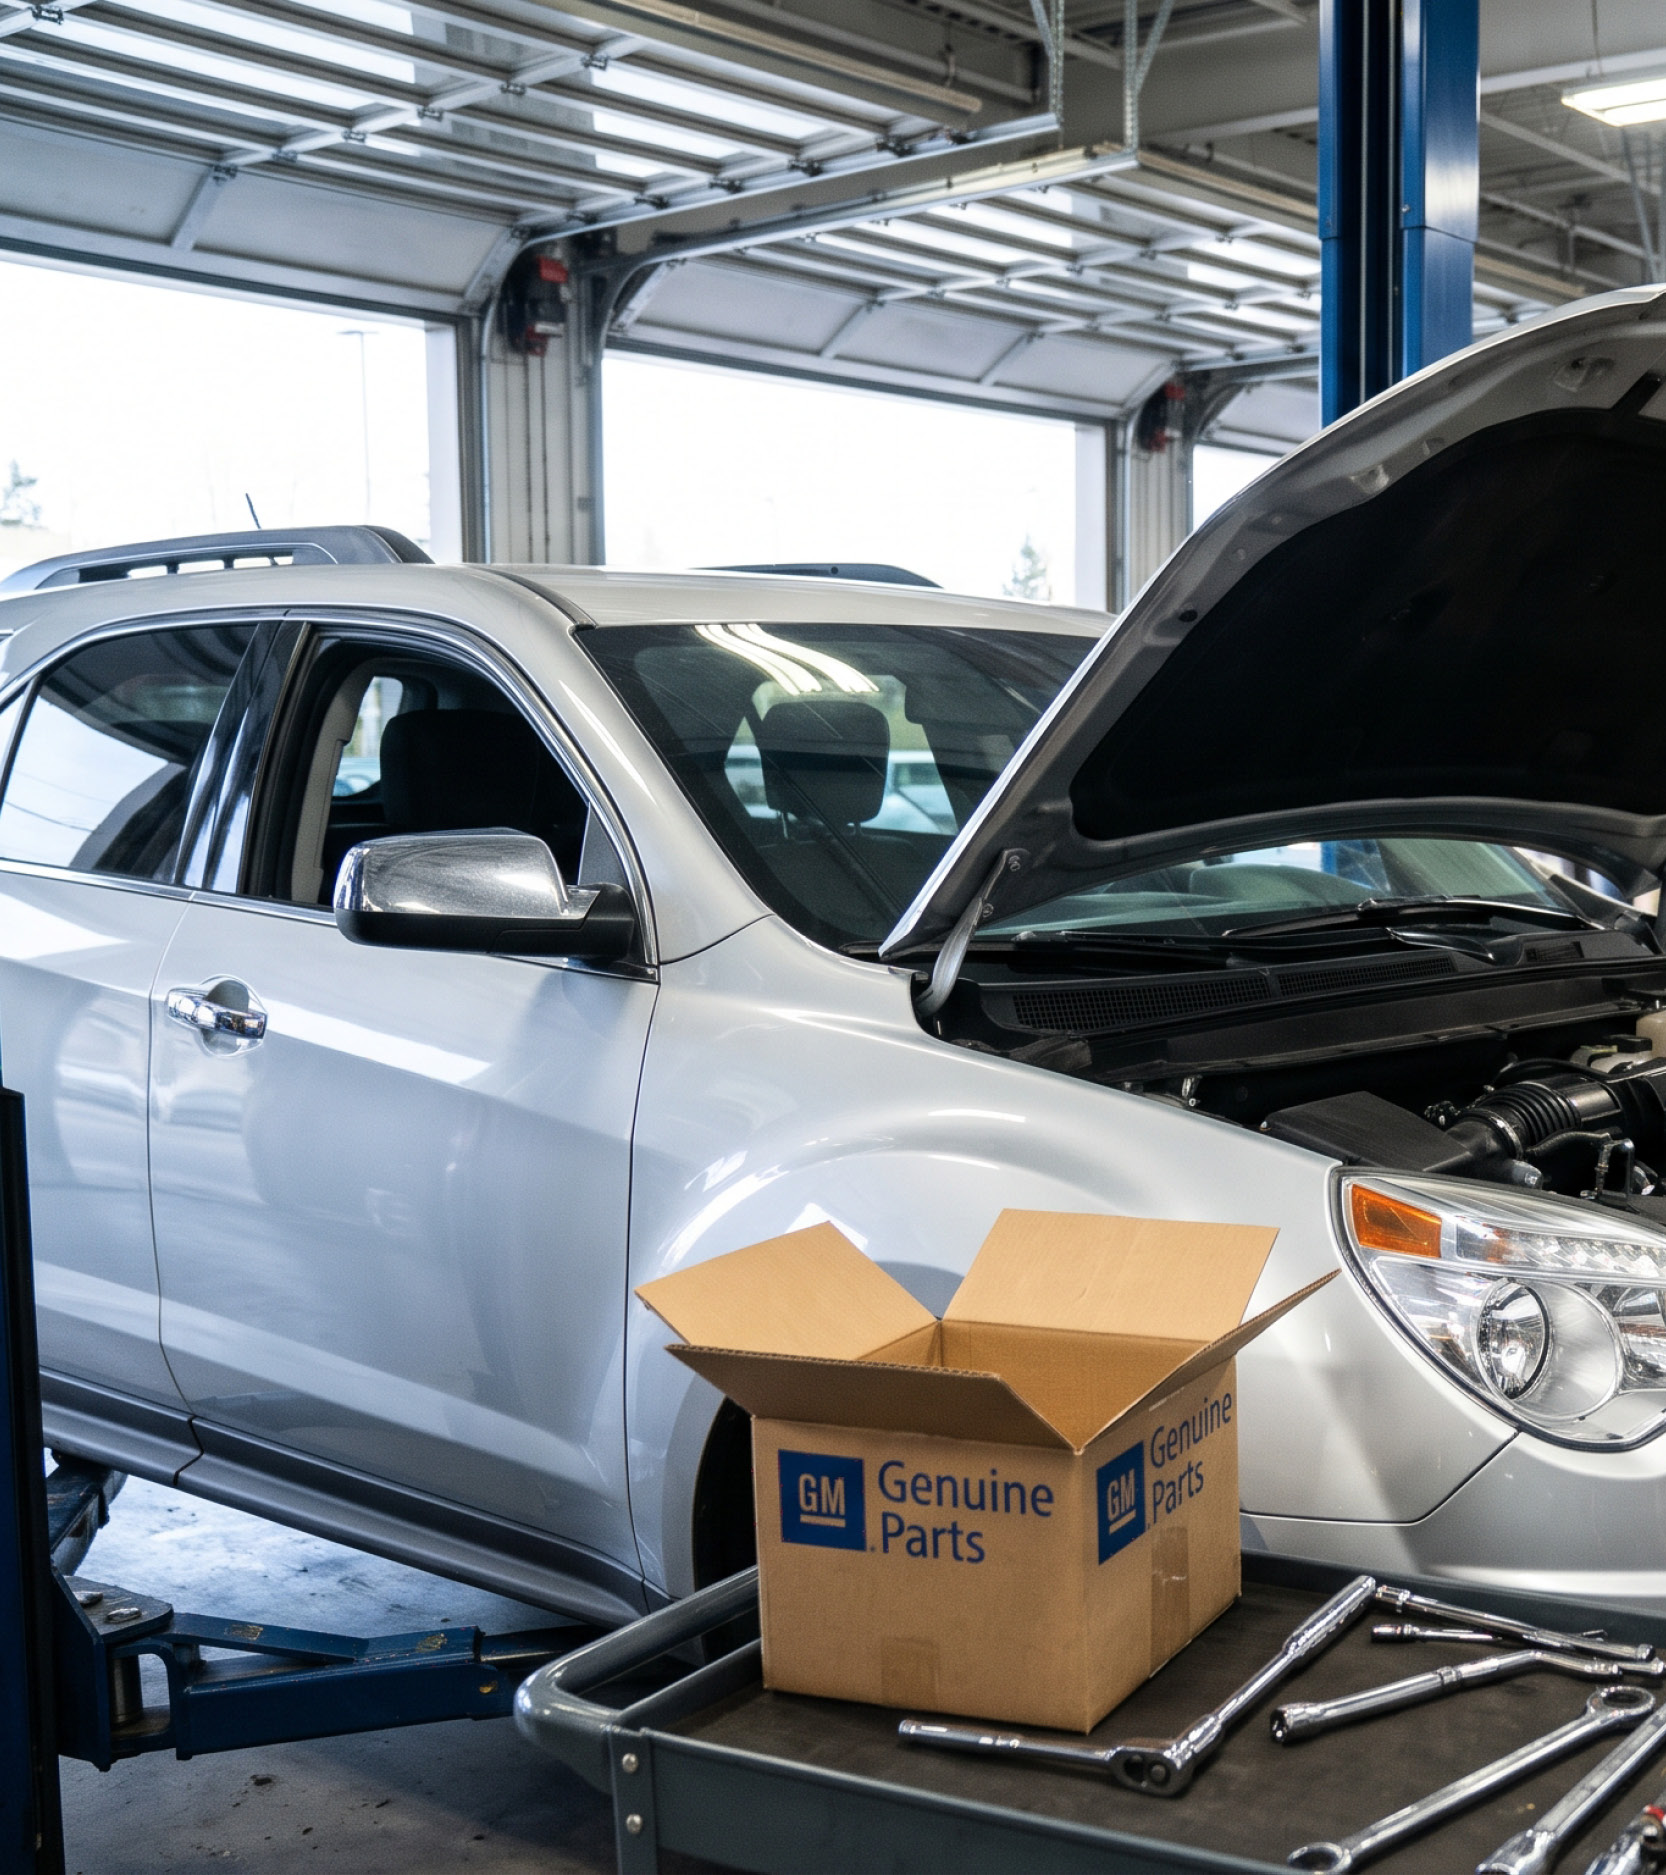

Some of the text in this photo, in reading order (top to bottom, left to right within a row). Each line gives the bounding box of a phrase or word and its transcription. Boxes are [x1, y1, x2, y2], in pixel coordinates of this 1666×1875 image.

[1107, 1391, 1233, 1522] GM Genuine
[798, 1459, 1055, 1518] GM Genuine
[1151, 1456, 1205, 1520] Parts
[881, 1511, 986, 1564] Parts
